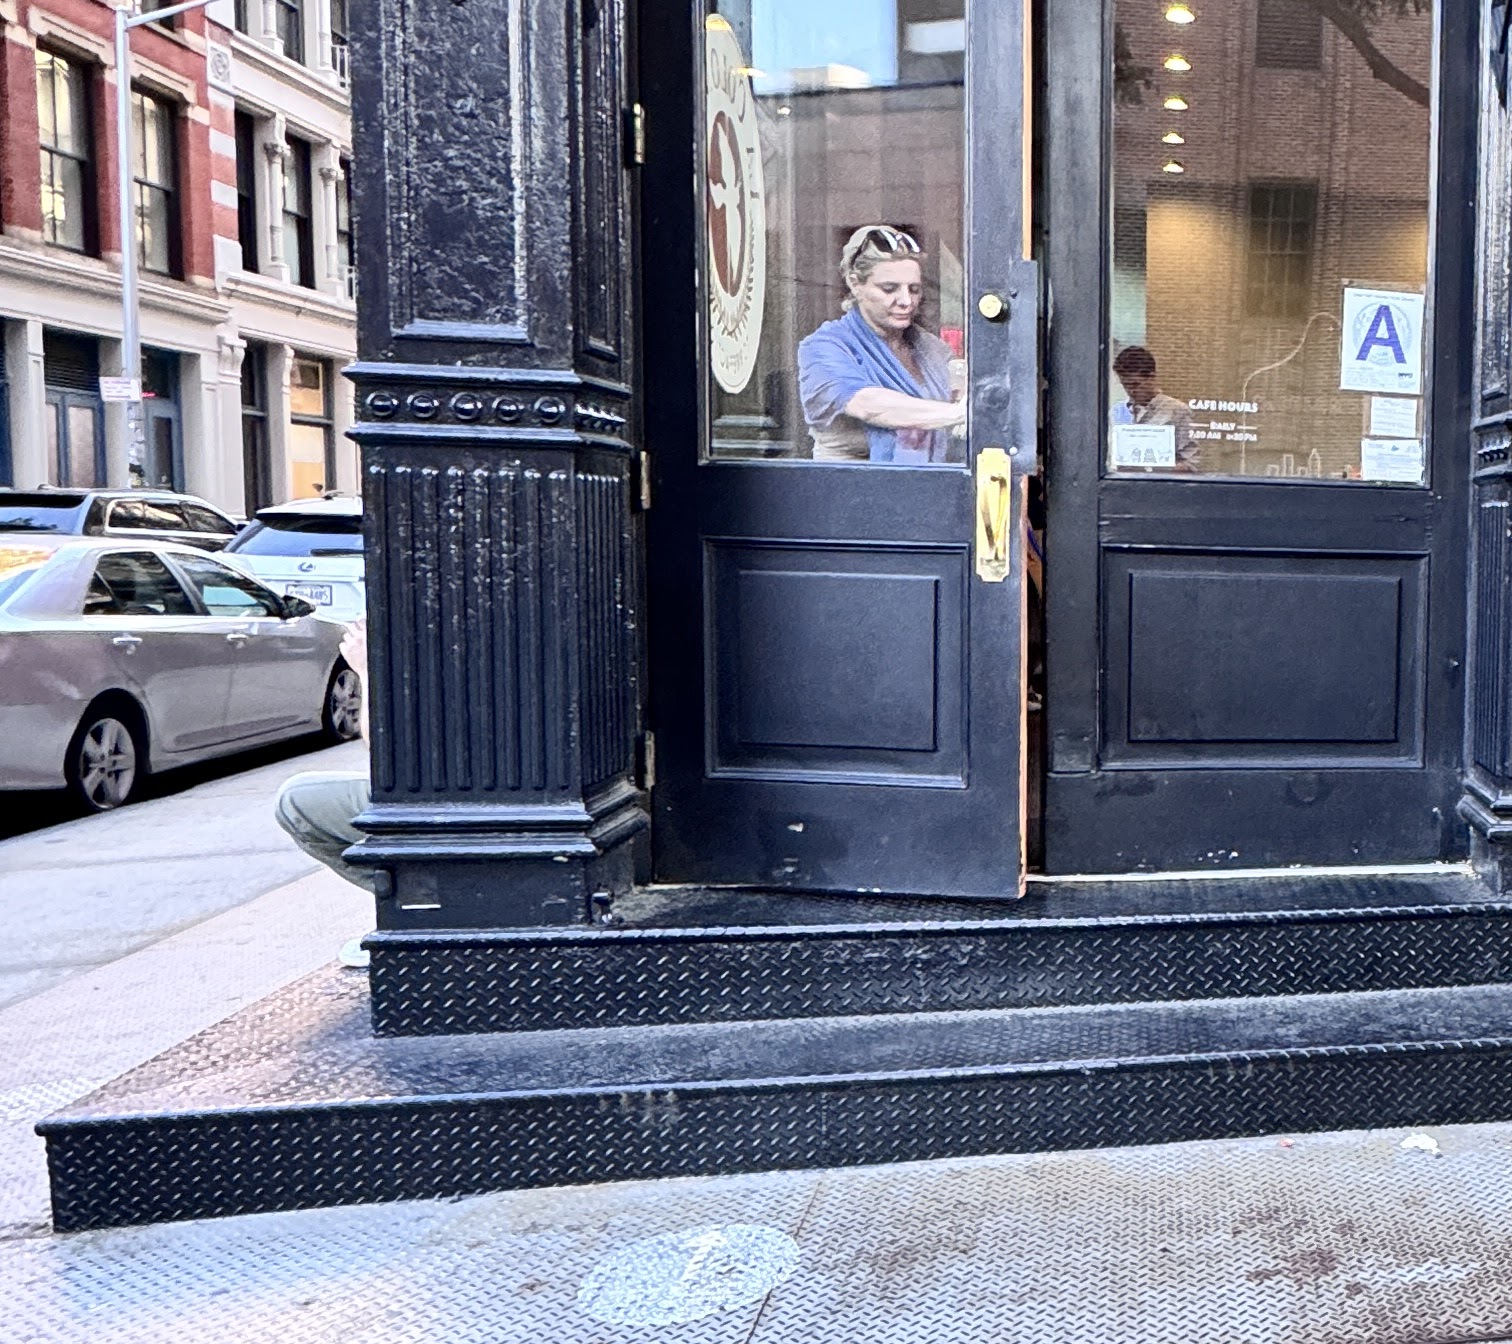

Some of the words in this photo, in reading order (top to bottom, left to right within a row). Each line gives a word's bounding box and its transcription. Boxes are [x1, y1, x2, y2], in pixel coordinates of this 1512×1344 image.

[1355, 303, 1408, 365] A
[1188, 399, 1217, 411] CAFE
[1218, 401, 1259, 413] HOURS
